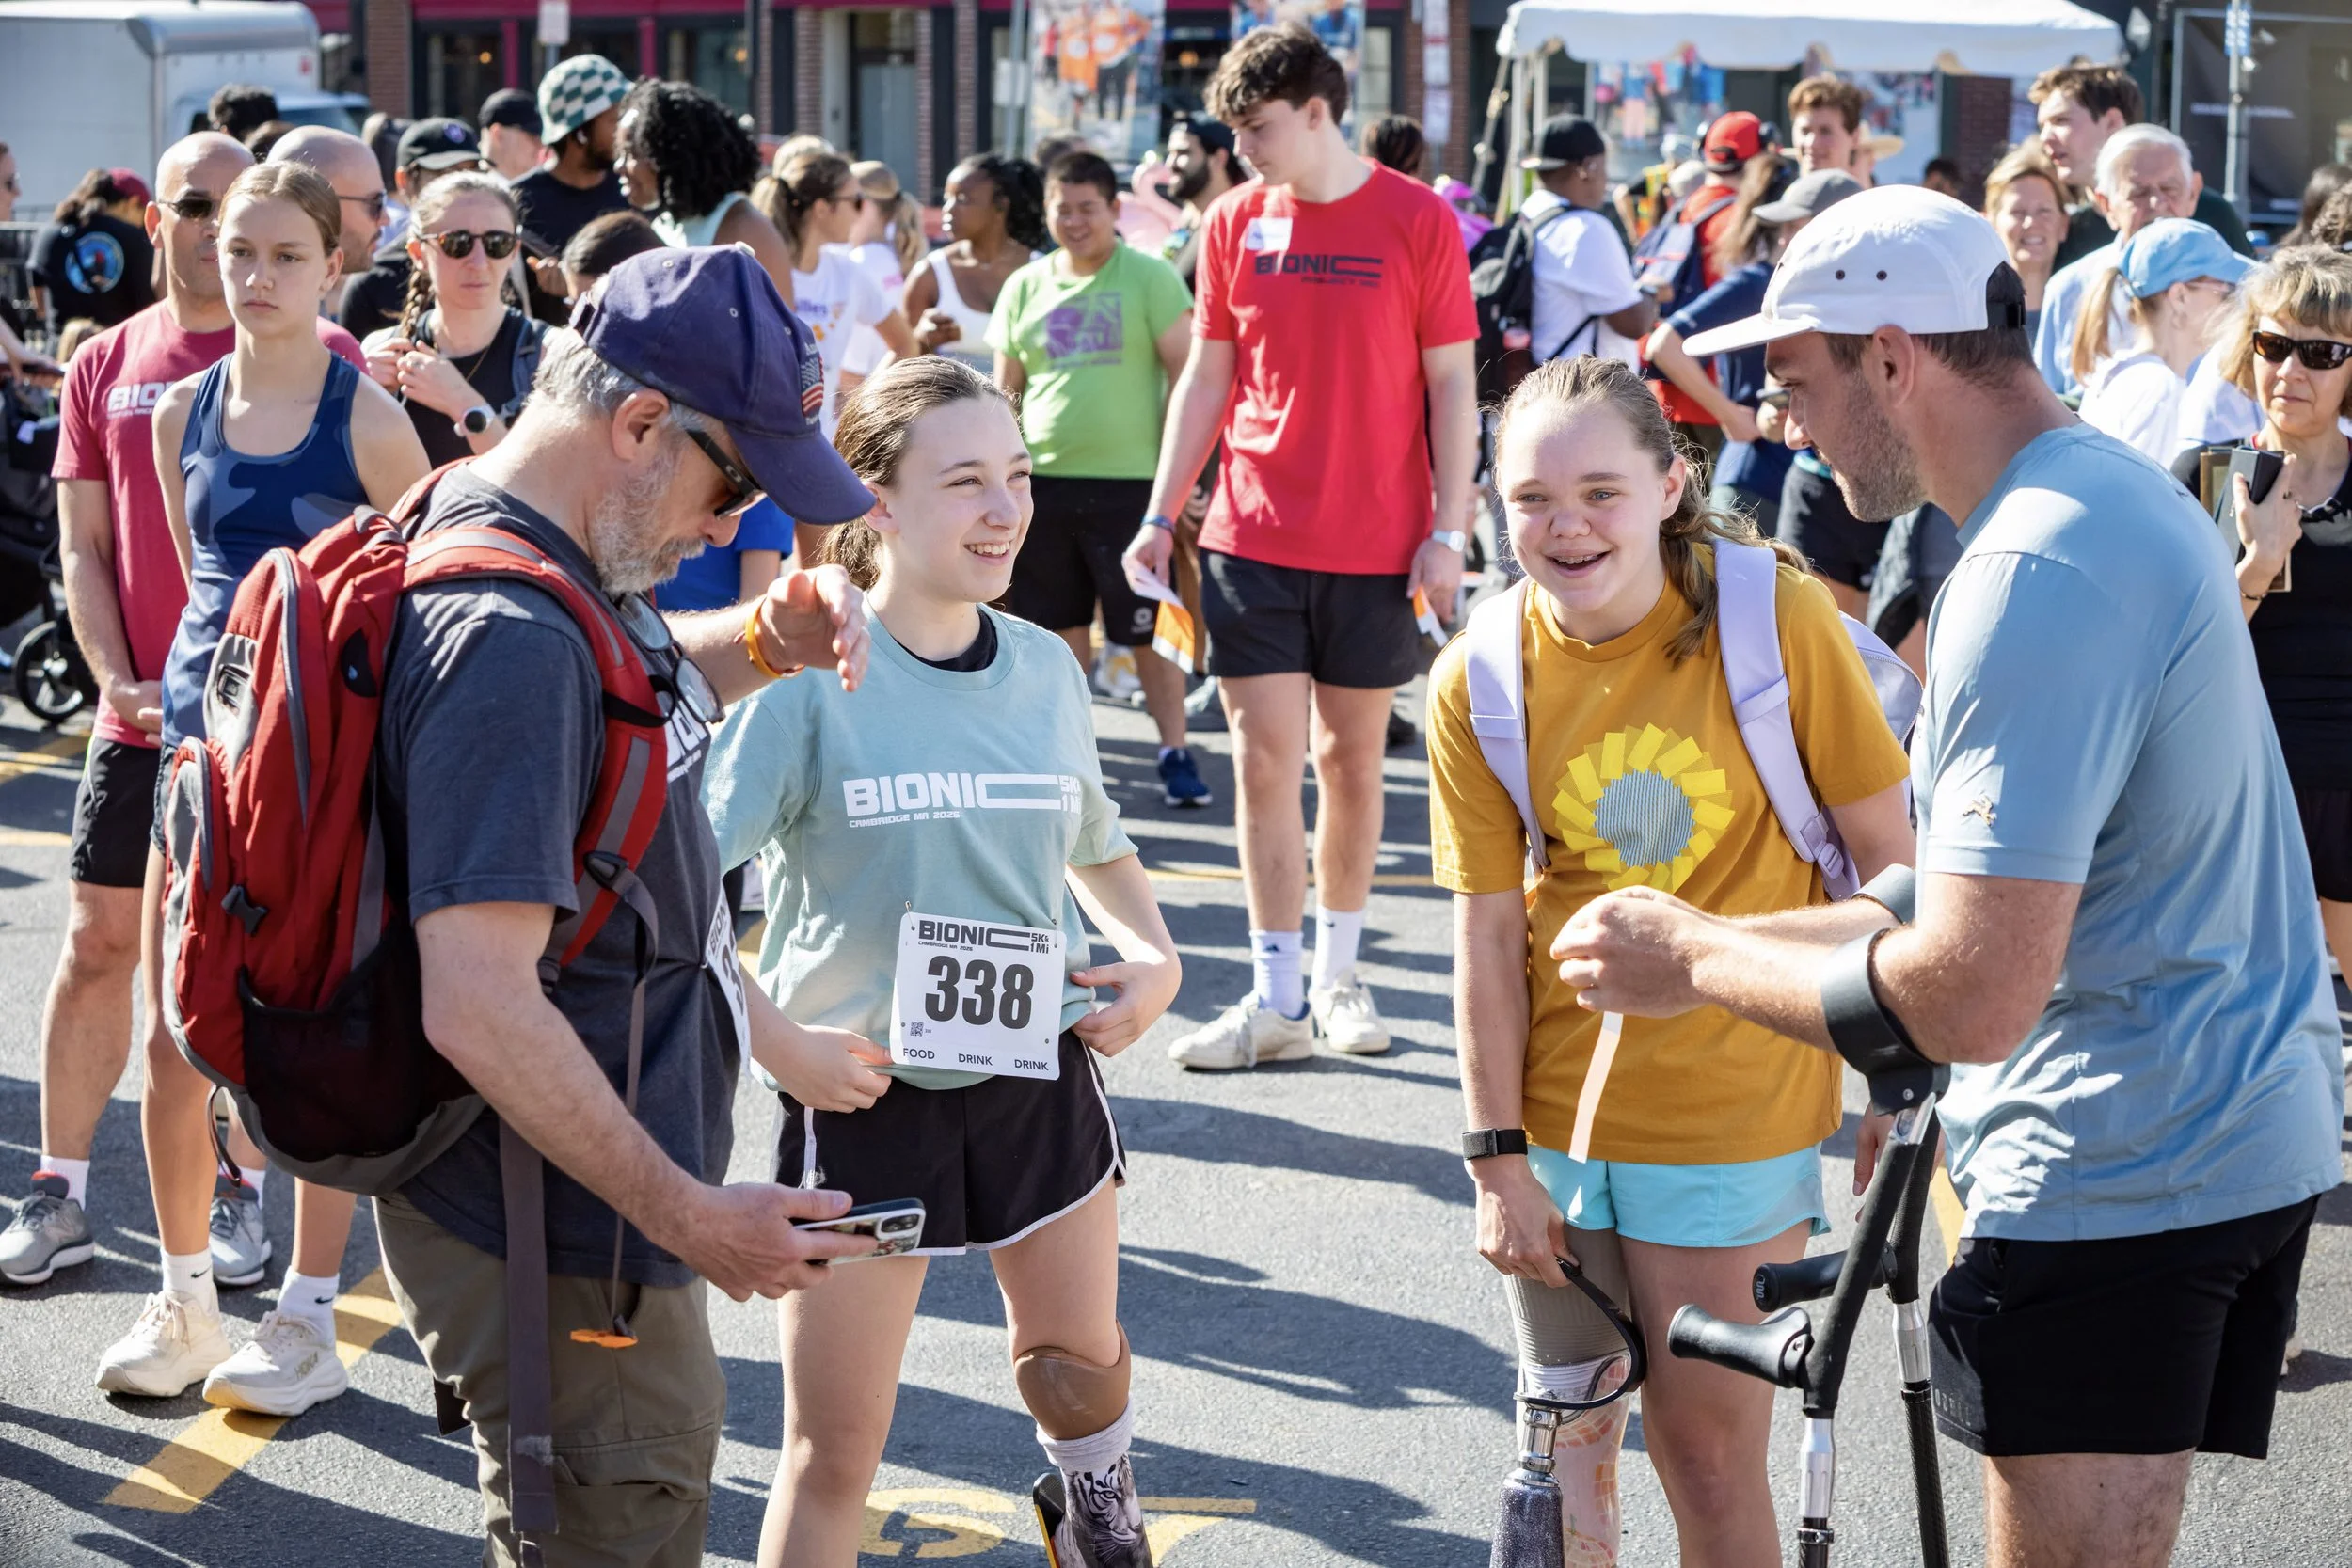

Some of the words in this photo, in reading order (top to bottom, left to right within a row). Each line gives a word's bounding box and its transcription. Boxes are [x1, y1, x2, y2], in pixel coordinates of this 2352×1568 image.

[107, 381, 176, 412] BIO
[843, 772, 1061, 816] BIONIC
[849, 814, 910, 828] CAMBRIDGE
[914, 812, 930, 821] MA
[933, 811, 961, 819] 2026
[918, 919, 1031, 952] BIONIC
[1030, 932, 1050, 943] 5K&
[925, 955, 1034, 1029] 338
[903, 1048, 935, 1060] FOOD
[958, 1053, 993, 1066] DRINK
[1014, 1059, 1049, 1070] DRINK
